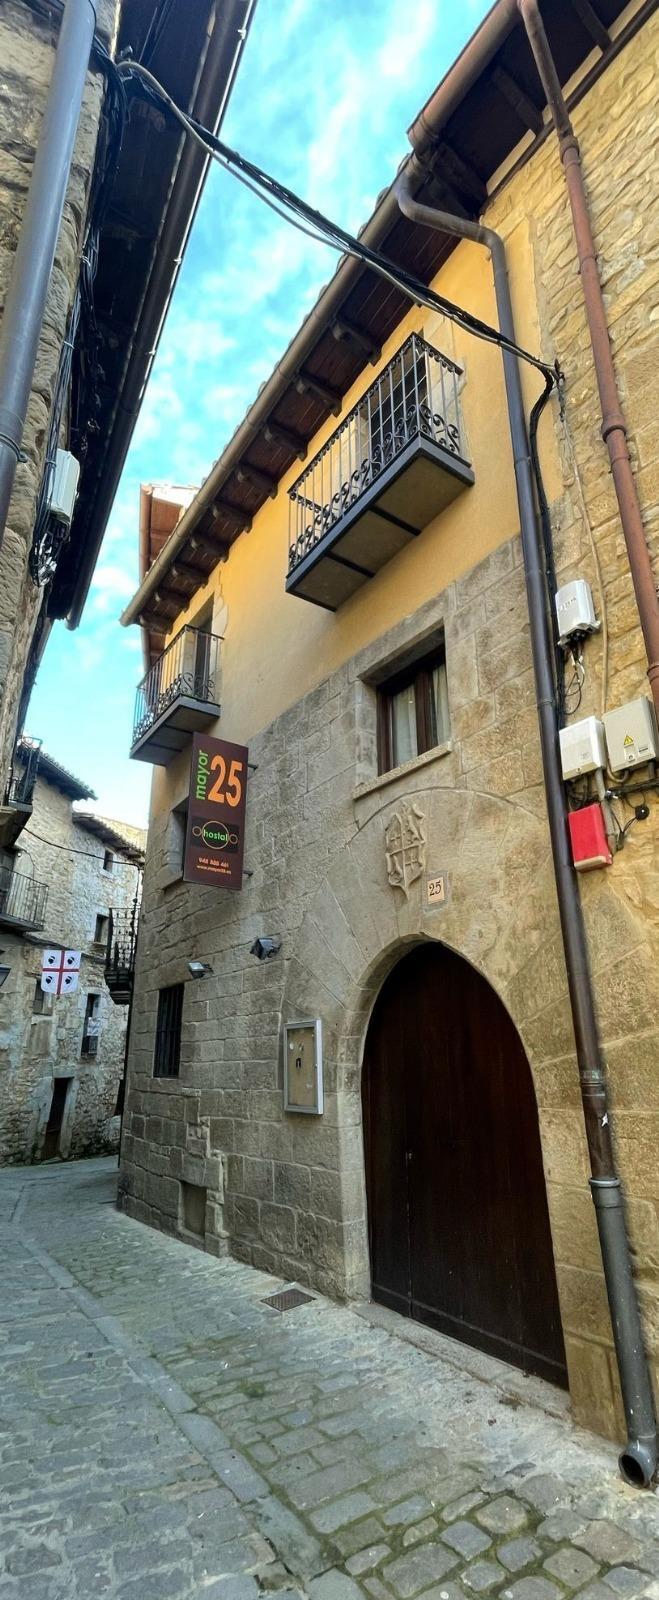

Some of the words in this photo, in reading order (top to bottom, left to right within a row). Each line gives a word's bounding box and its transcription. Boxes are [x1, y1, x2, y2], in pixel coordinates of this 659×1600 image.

[196, 750, 210, 800] mayor
[208, 755, 242, 807] 25
[203, 829, 228, 841] hostal
[428, 880, 442, 896] 25
